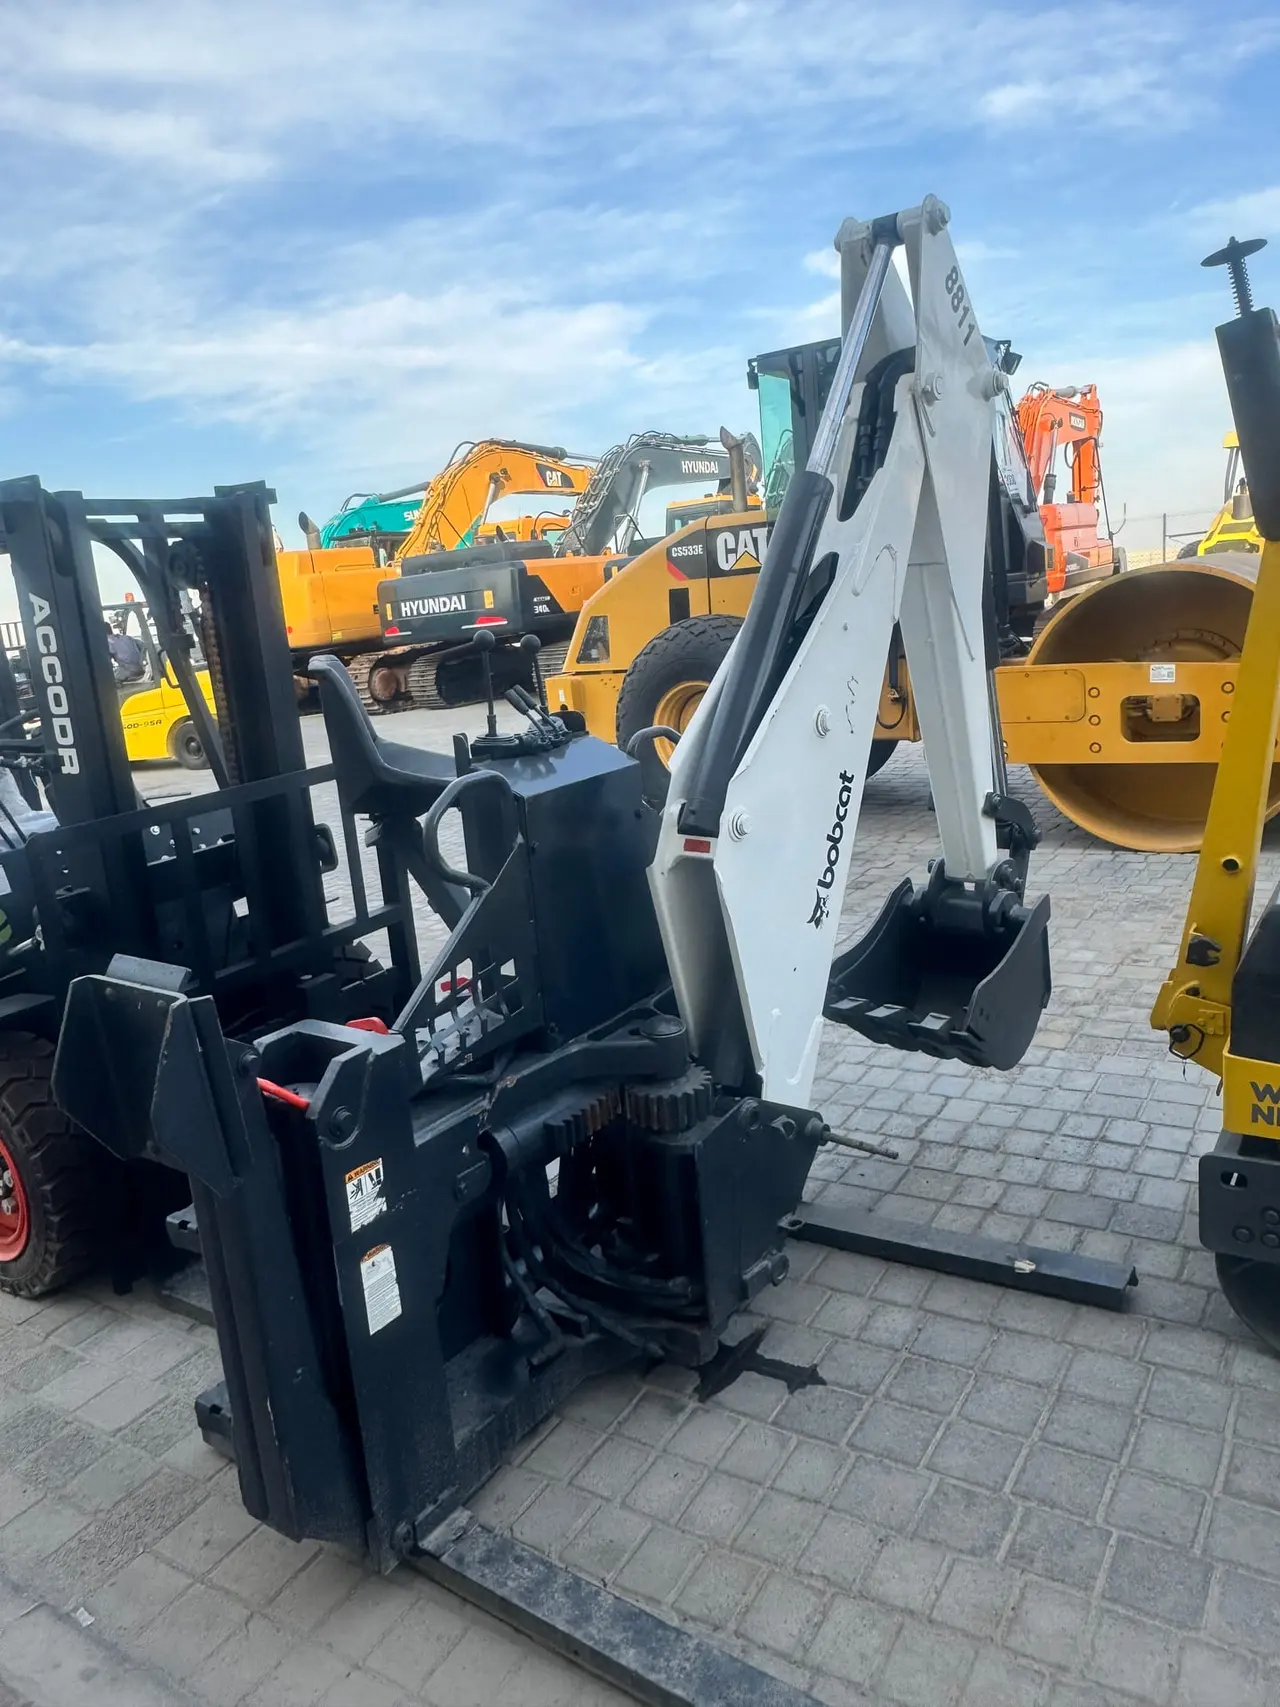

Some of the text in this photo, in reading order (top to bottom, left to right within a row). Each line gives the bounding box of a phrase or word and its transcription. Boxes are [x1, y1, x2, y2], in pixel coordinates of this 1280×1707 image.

[945, 265, 975, 347] 8811
[545, 470, 563, 487] CAT
[681, 460, 719, 474] HYUNDAI
[671, 544, 704, 557] CS533E
[716, 527, 768, 571] CAT
[400, 594, 467, 618] HYUNDAI
[28, 592, 80, 775] ACCODR
[817, 769, 855, 890] bobcat
